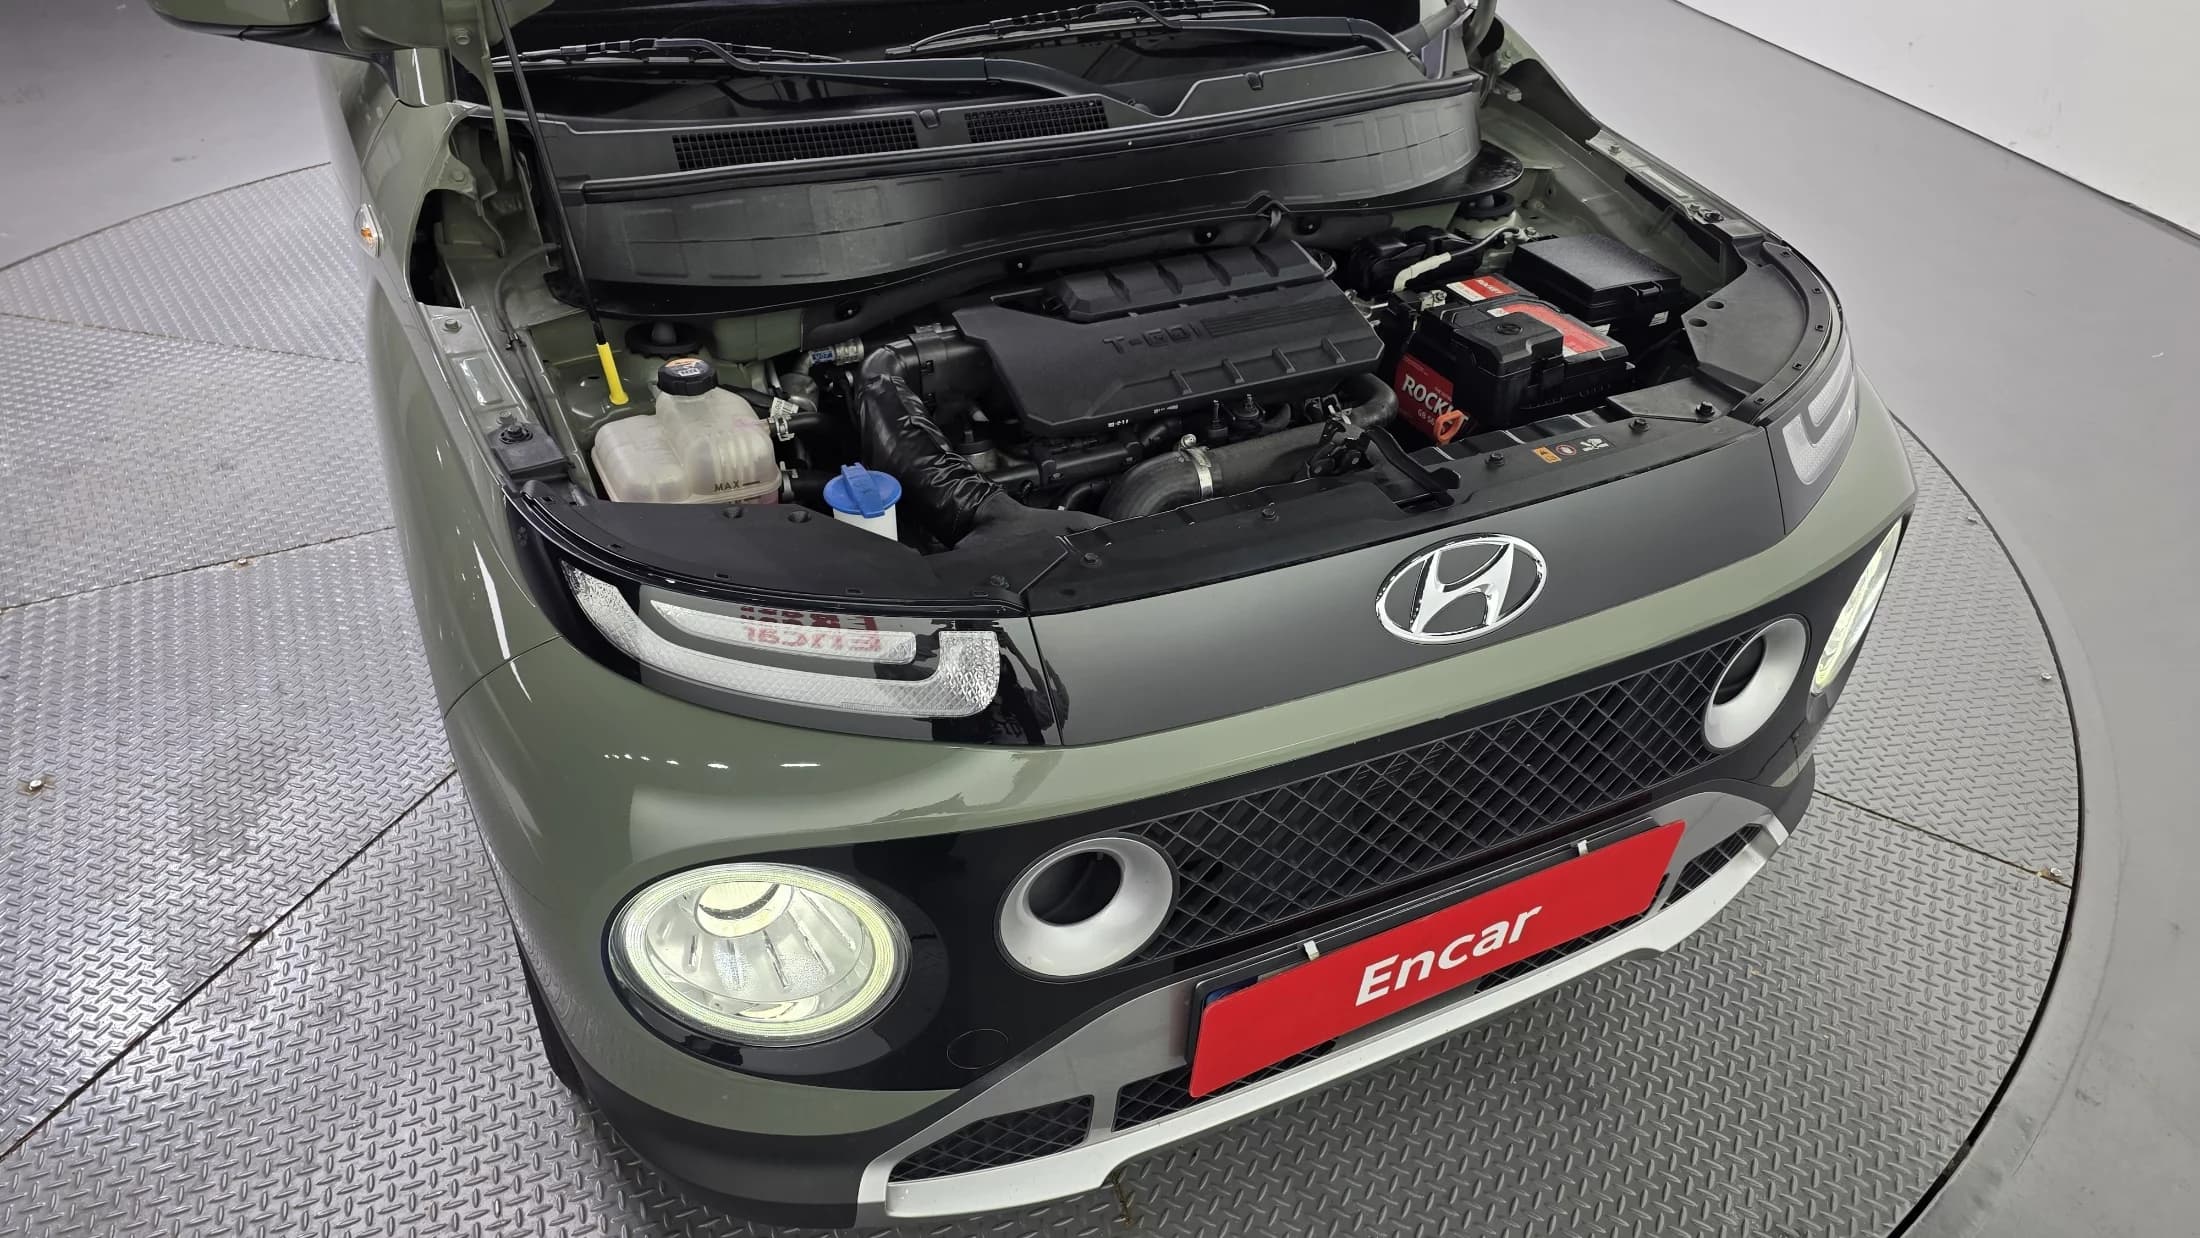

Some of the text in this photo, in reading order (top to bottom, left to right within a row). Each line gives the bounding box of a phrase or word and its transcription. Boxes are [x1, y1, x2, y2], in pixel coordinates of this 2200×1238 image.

[1402, 374, 1469, 424] ROCK
[714, 480, 740, 492] MAX
[1355, 905, 1542, 1007] Encar
